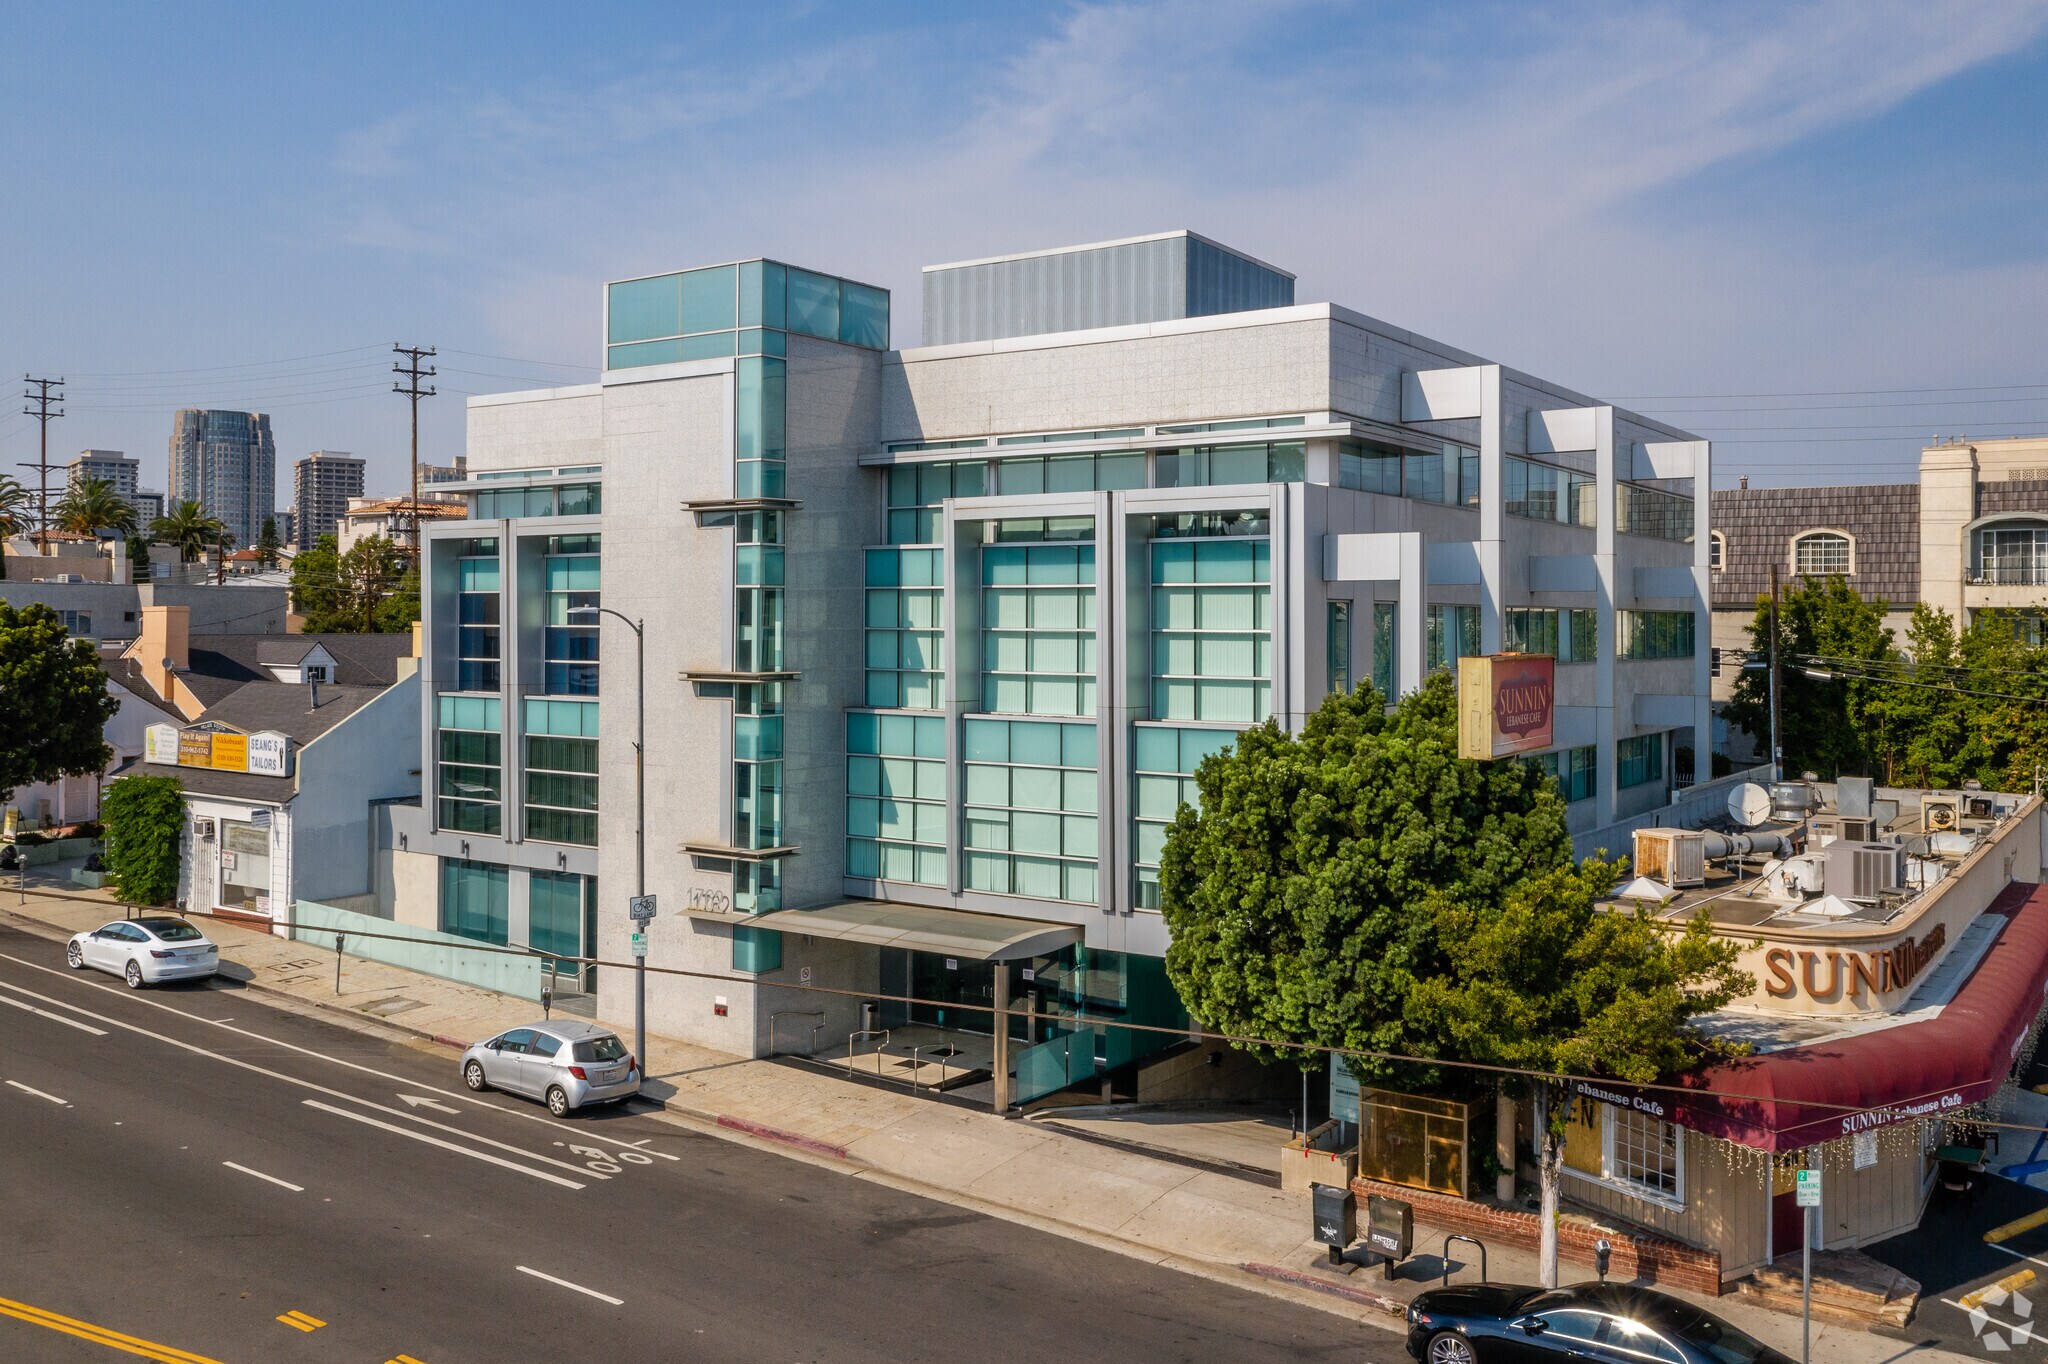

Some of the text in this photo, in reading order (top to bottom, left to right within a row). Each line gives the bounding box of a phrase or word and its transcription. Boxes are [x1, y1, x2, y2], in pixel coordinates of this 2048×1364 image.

[1500, 686, 1546, 715] SUNNIN
[1506, 713, 1530, 727] LEBANESE
[180, 731, 190, 741] Play
[251, 738, 278, 752] SEANG'S
[251, 756, 277, 771] TAILORS
[1569, 1079, 1630, 1105] ebanese
[1633, 1096, 1664, 1116] Cafe
[1841, 1107, 1892, 1134] SUNNIN
[1941, 1093, 1962, 1108] Cafe
[1800, 1172, 1805, 1181] 2
